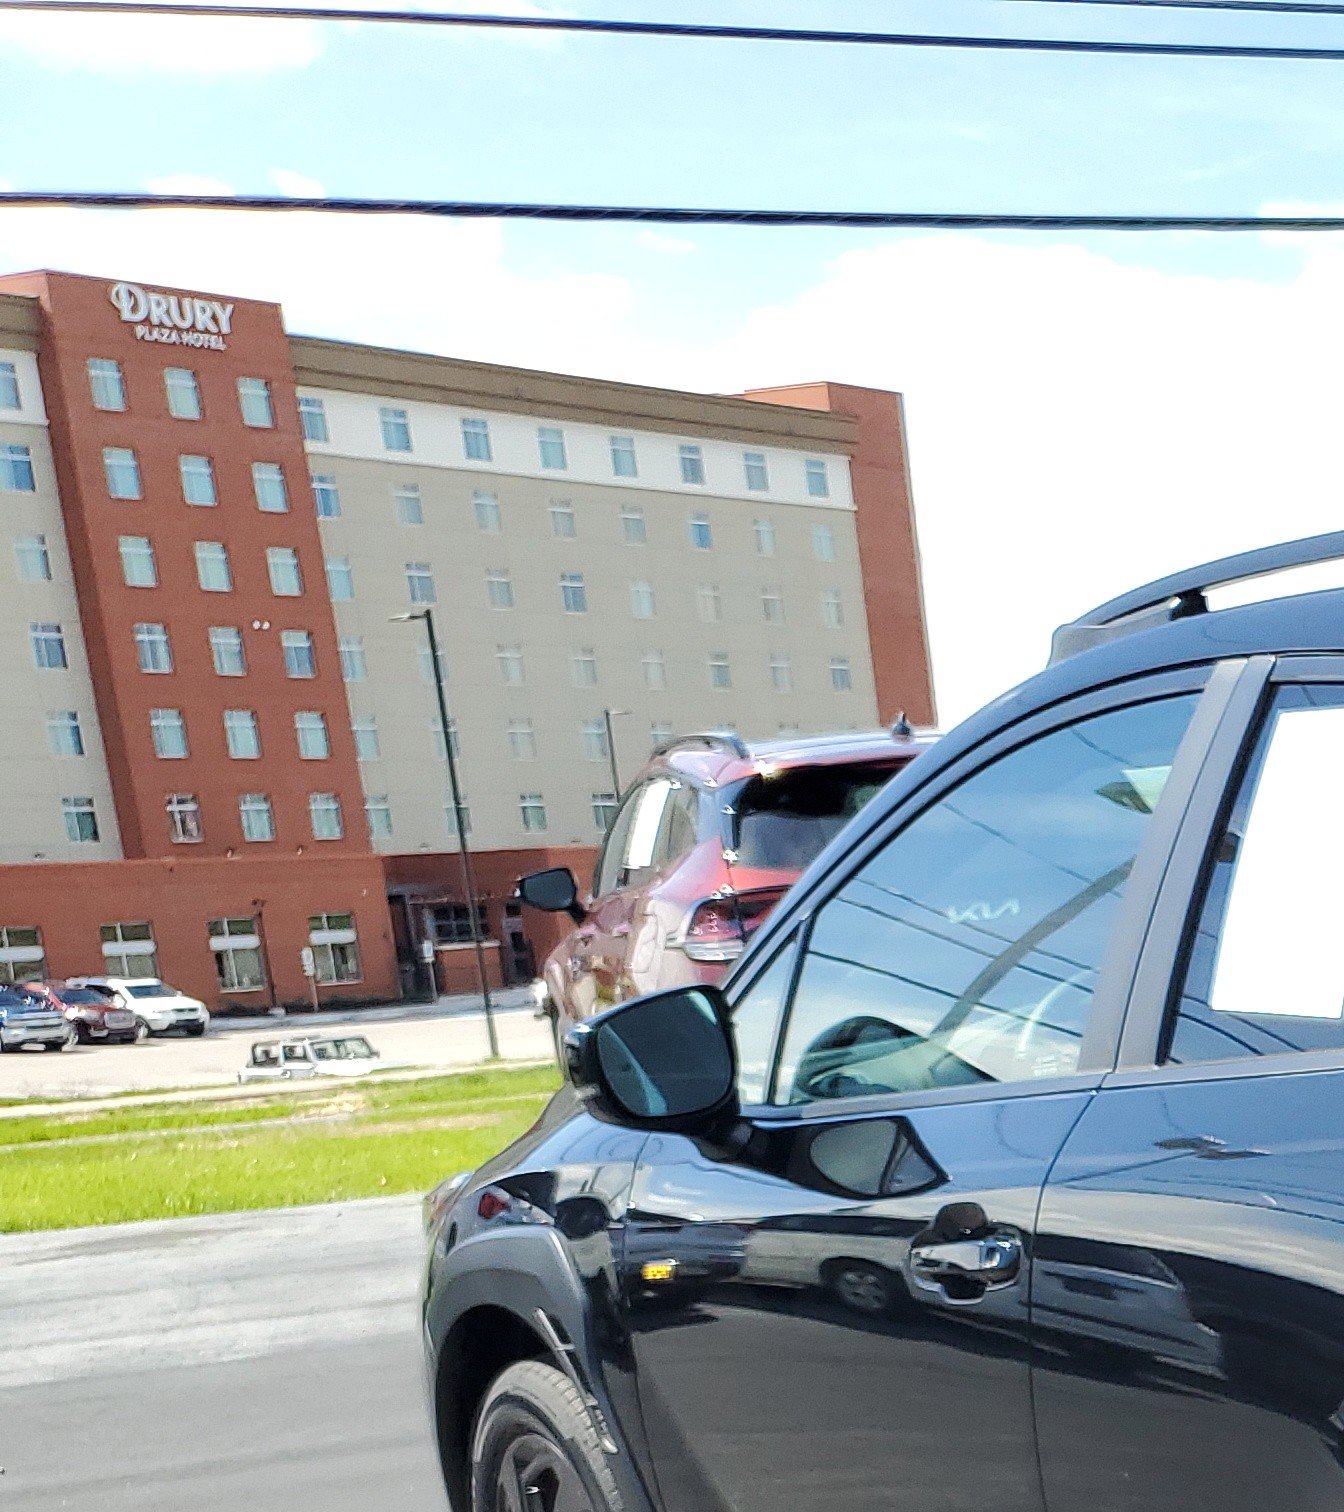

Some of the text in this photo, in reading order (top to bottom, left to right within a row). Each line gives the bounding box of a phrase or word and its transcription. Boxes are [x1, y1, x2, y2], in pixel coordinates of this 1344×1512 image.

[110, 282, 234, 334] DRURY
[134, 325, 228, 350] PLAZA HOTEL
